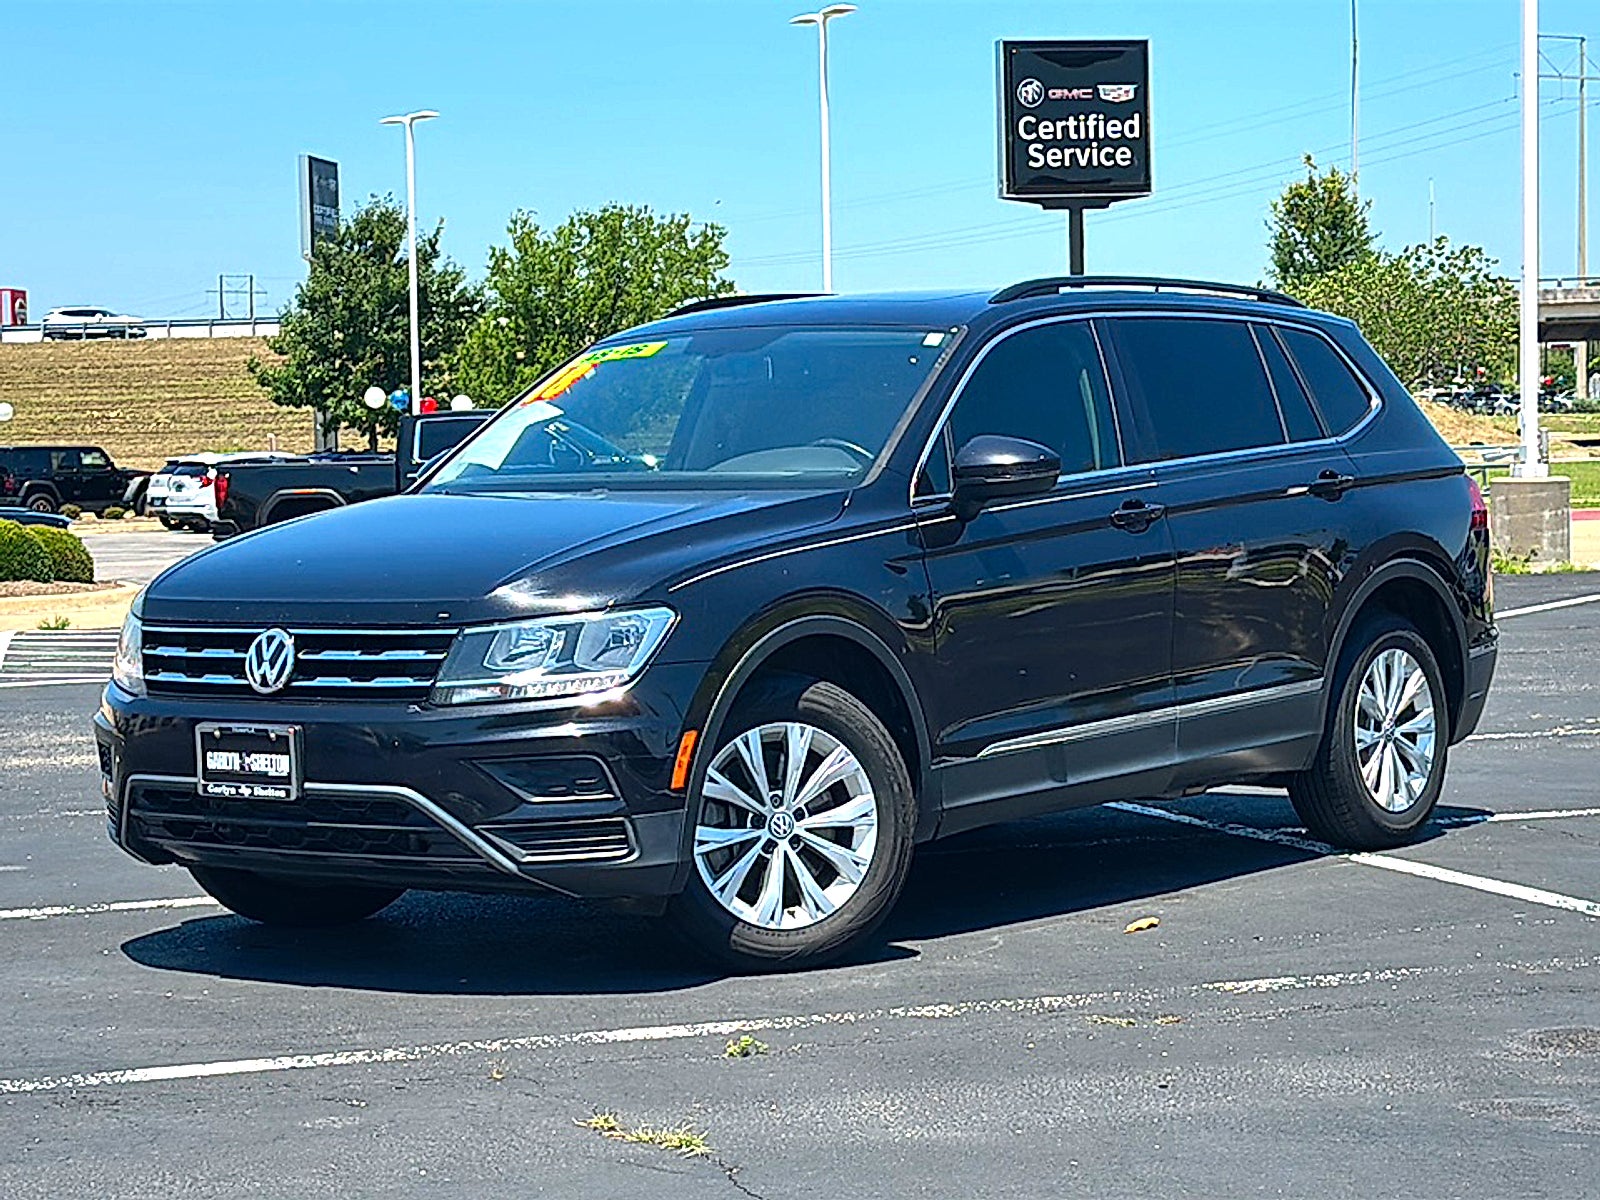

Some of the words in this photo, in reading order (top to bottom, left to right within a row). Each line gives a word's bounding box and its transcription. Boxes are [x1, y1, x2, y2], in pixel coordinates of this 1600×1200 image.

[1048, 88, 1093, 100] GMC
[1018, 112, 1140, 140] Certified
[1028, 142, 1132, 168] Service
